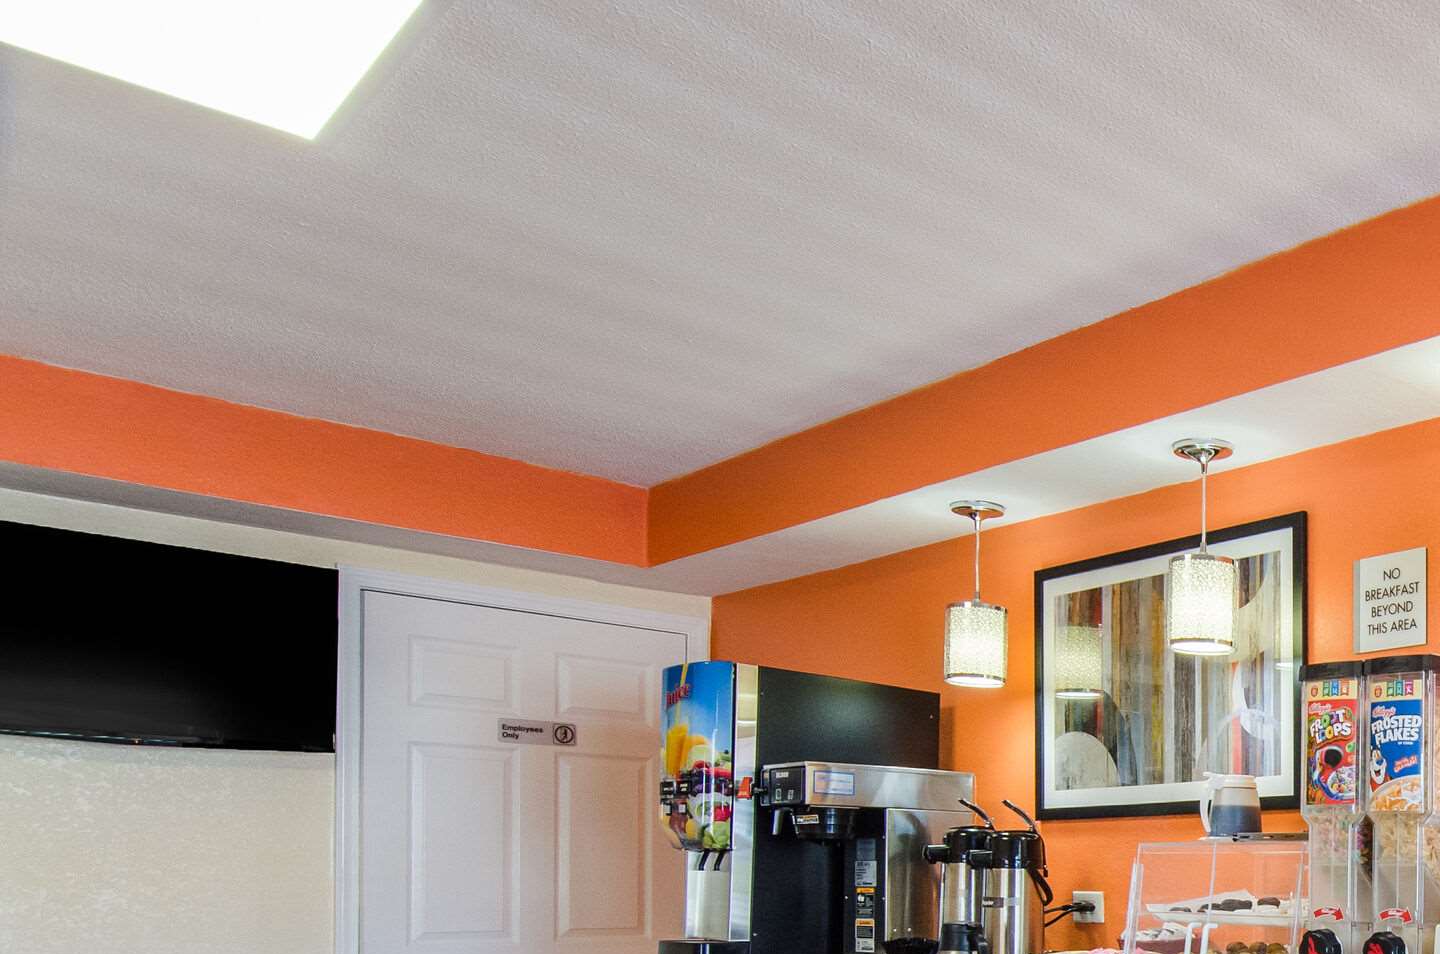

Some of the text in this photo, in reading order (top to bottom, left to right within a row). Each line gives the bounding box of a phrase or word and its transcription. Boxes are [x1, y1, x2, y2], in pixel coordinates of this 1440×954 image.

[1383, 567, 1401, 581] NO
[1365, 581, 1421, 602] BREAKFAST
[1371, 600, 1414, 618] BEYOND
[1367, 618, 1418, 636] THIS AREA
[501, 724, 543, 733] Employees
[1371, 714, 1422, 735] FROSTED
[502, 731, 519, 740] Only
[1374, 727, 1419, 749] FLAKES
